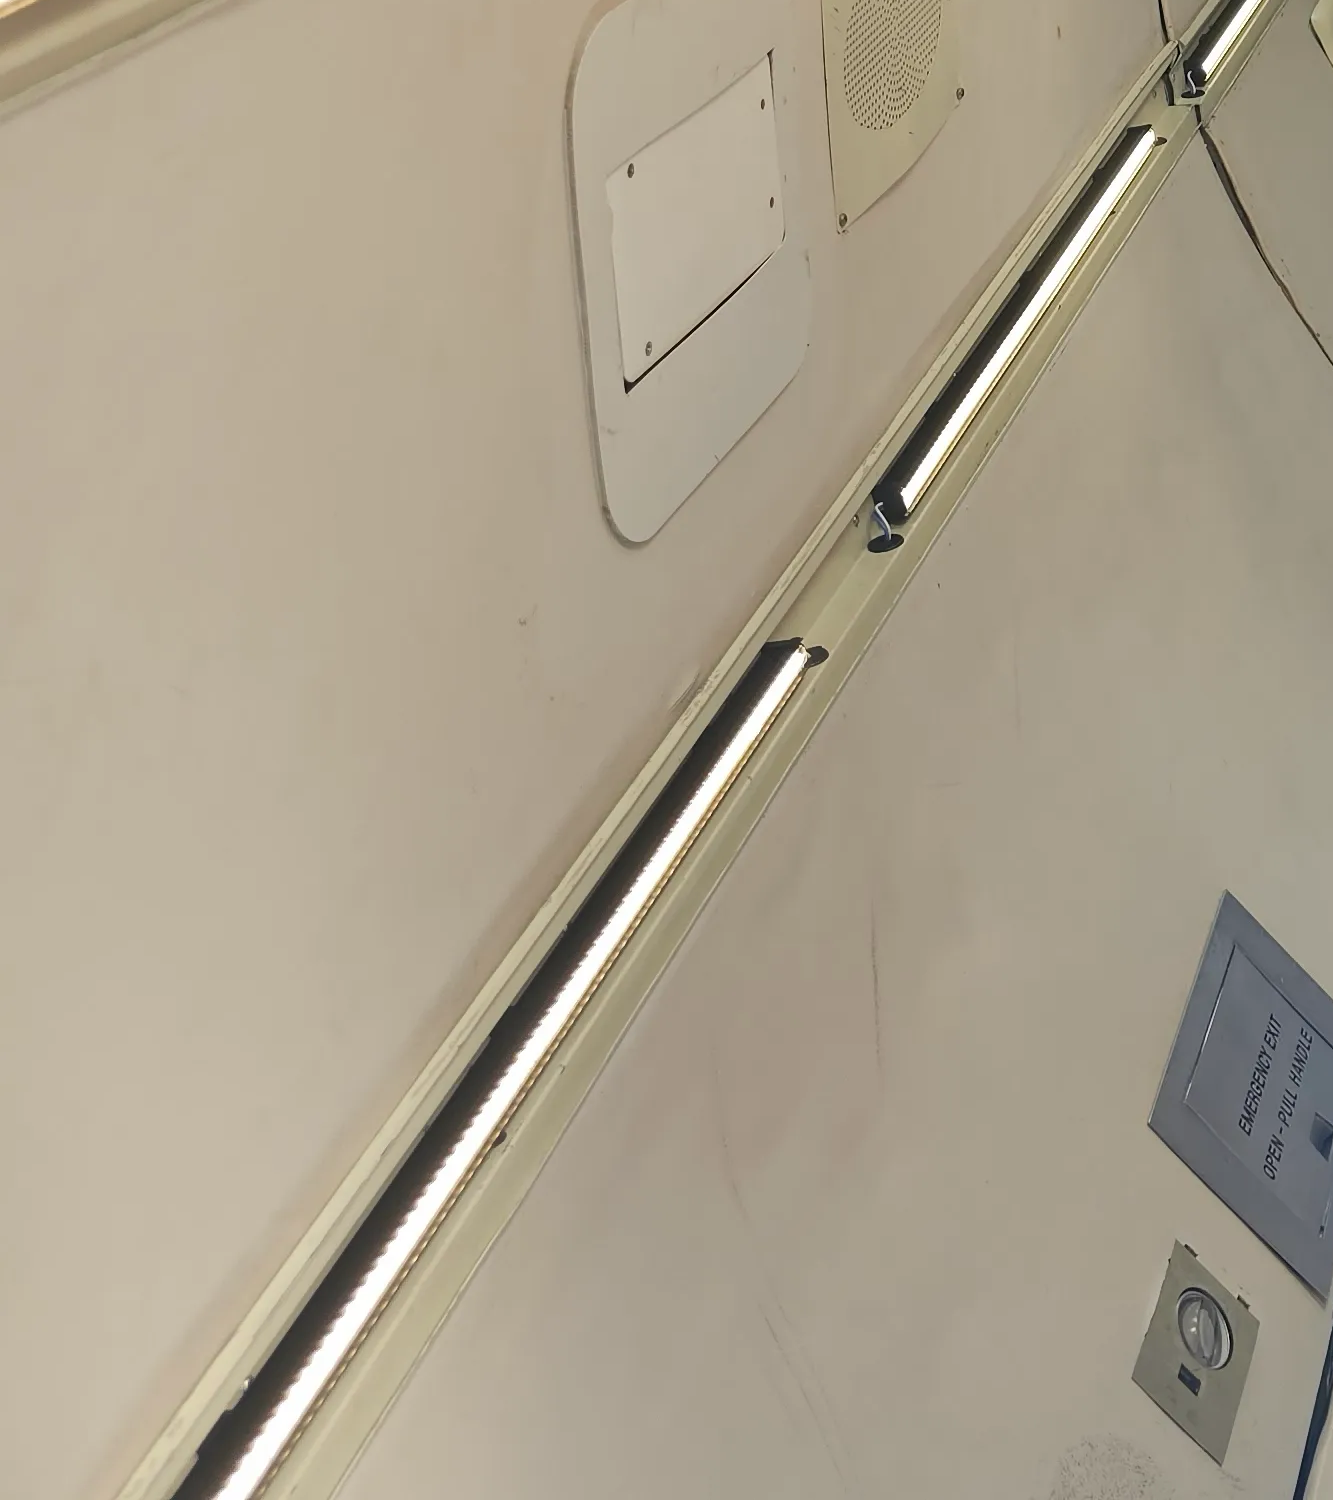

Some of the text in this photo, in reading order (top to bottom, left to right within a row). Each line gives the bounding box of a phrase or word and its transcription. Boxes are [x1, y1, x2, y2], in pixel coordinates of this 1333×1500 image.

[1238, 1013, 1282, 1137] EMERGENCY EXIT
[1262, 1133, 1284, 1181] OPEN
[1277, 1088, 1298, 1128] PULL
[1288, 1027, 1314, 1088] HANDLE
